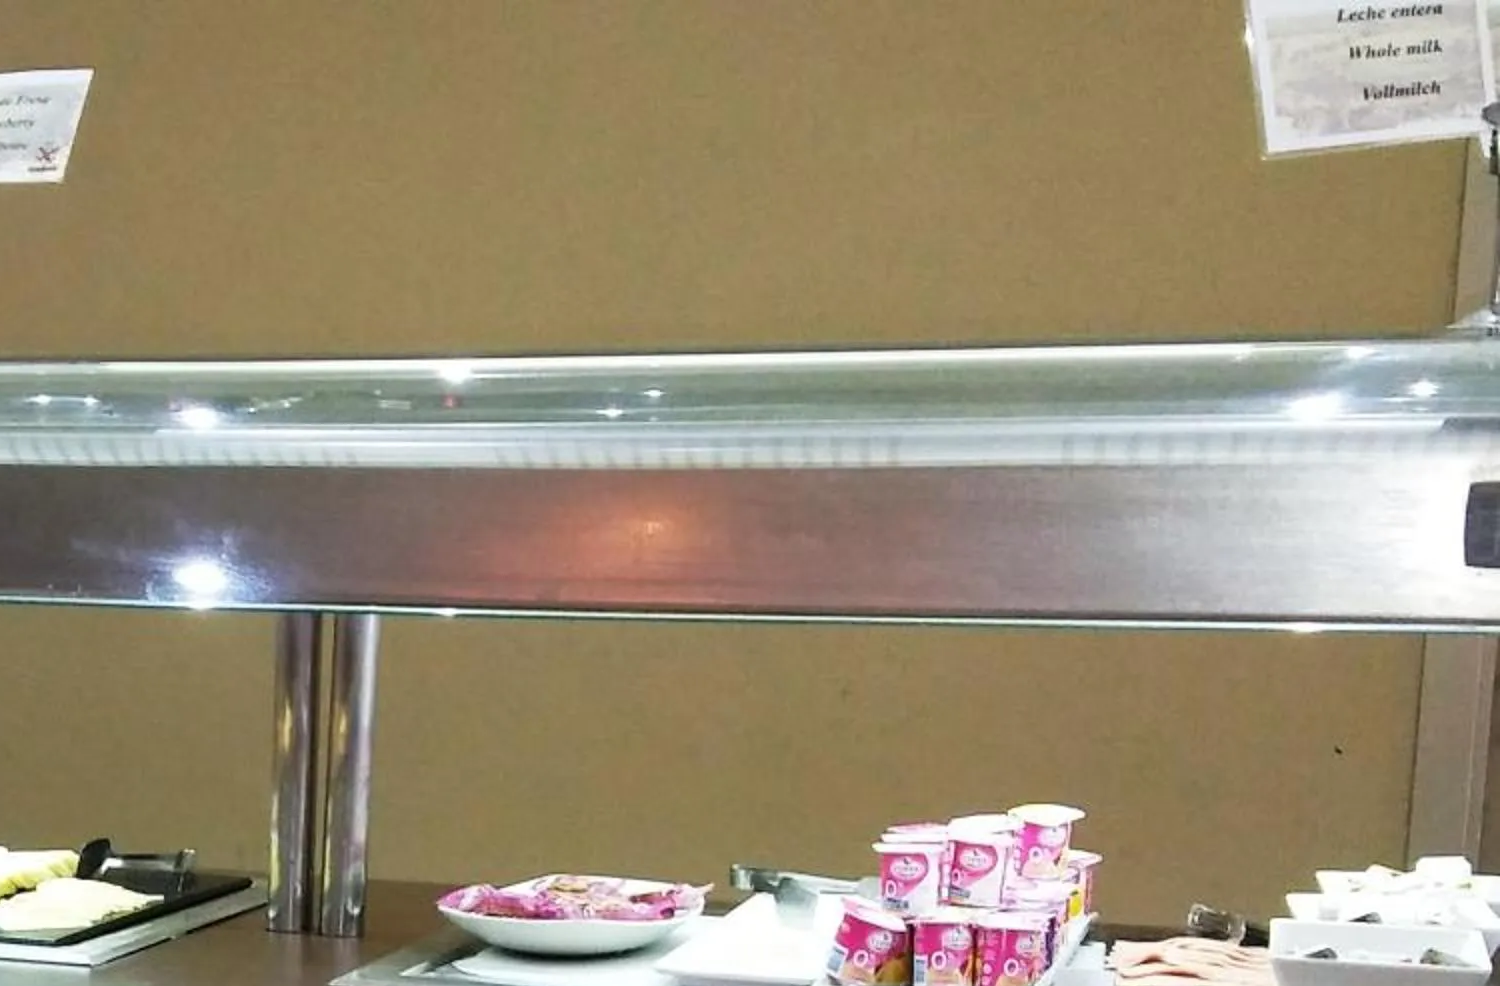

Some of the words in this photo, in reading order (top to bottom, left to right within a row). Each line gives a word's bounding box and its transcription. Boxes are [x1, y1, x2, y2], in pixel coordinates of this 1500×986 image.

[1337, 5, 1387, 23] Leche
[1390, 3, 1443, 19] entera
[1349, 42, 1401, 60] Whole
[1407, 38, 1443, 55] milk
[1363, 80, 1442, 101] Vollmilch
